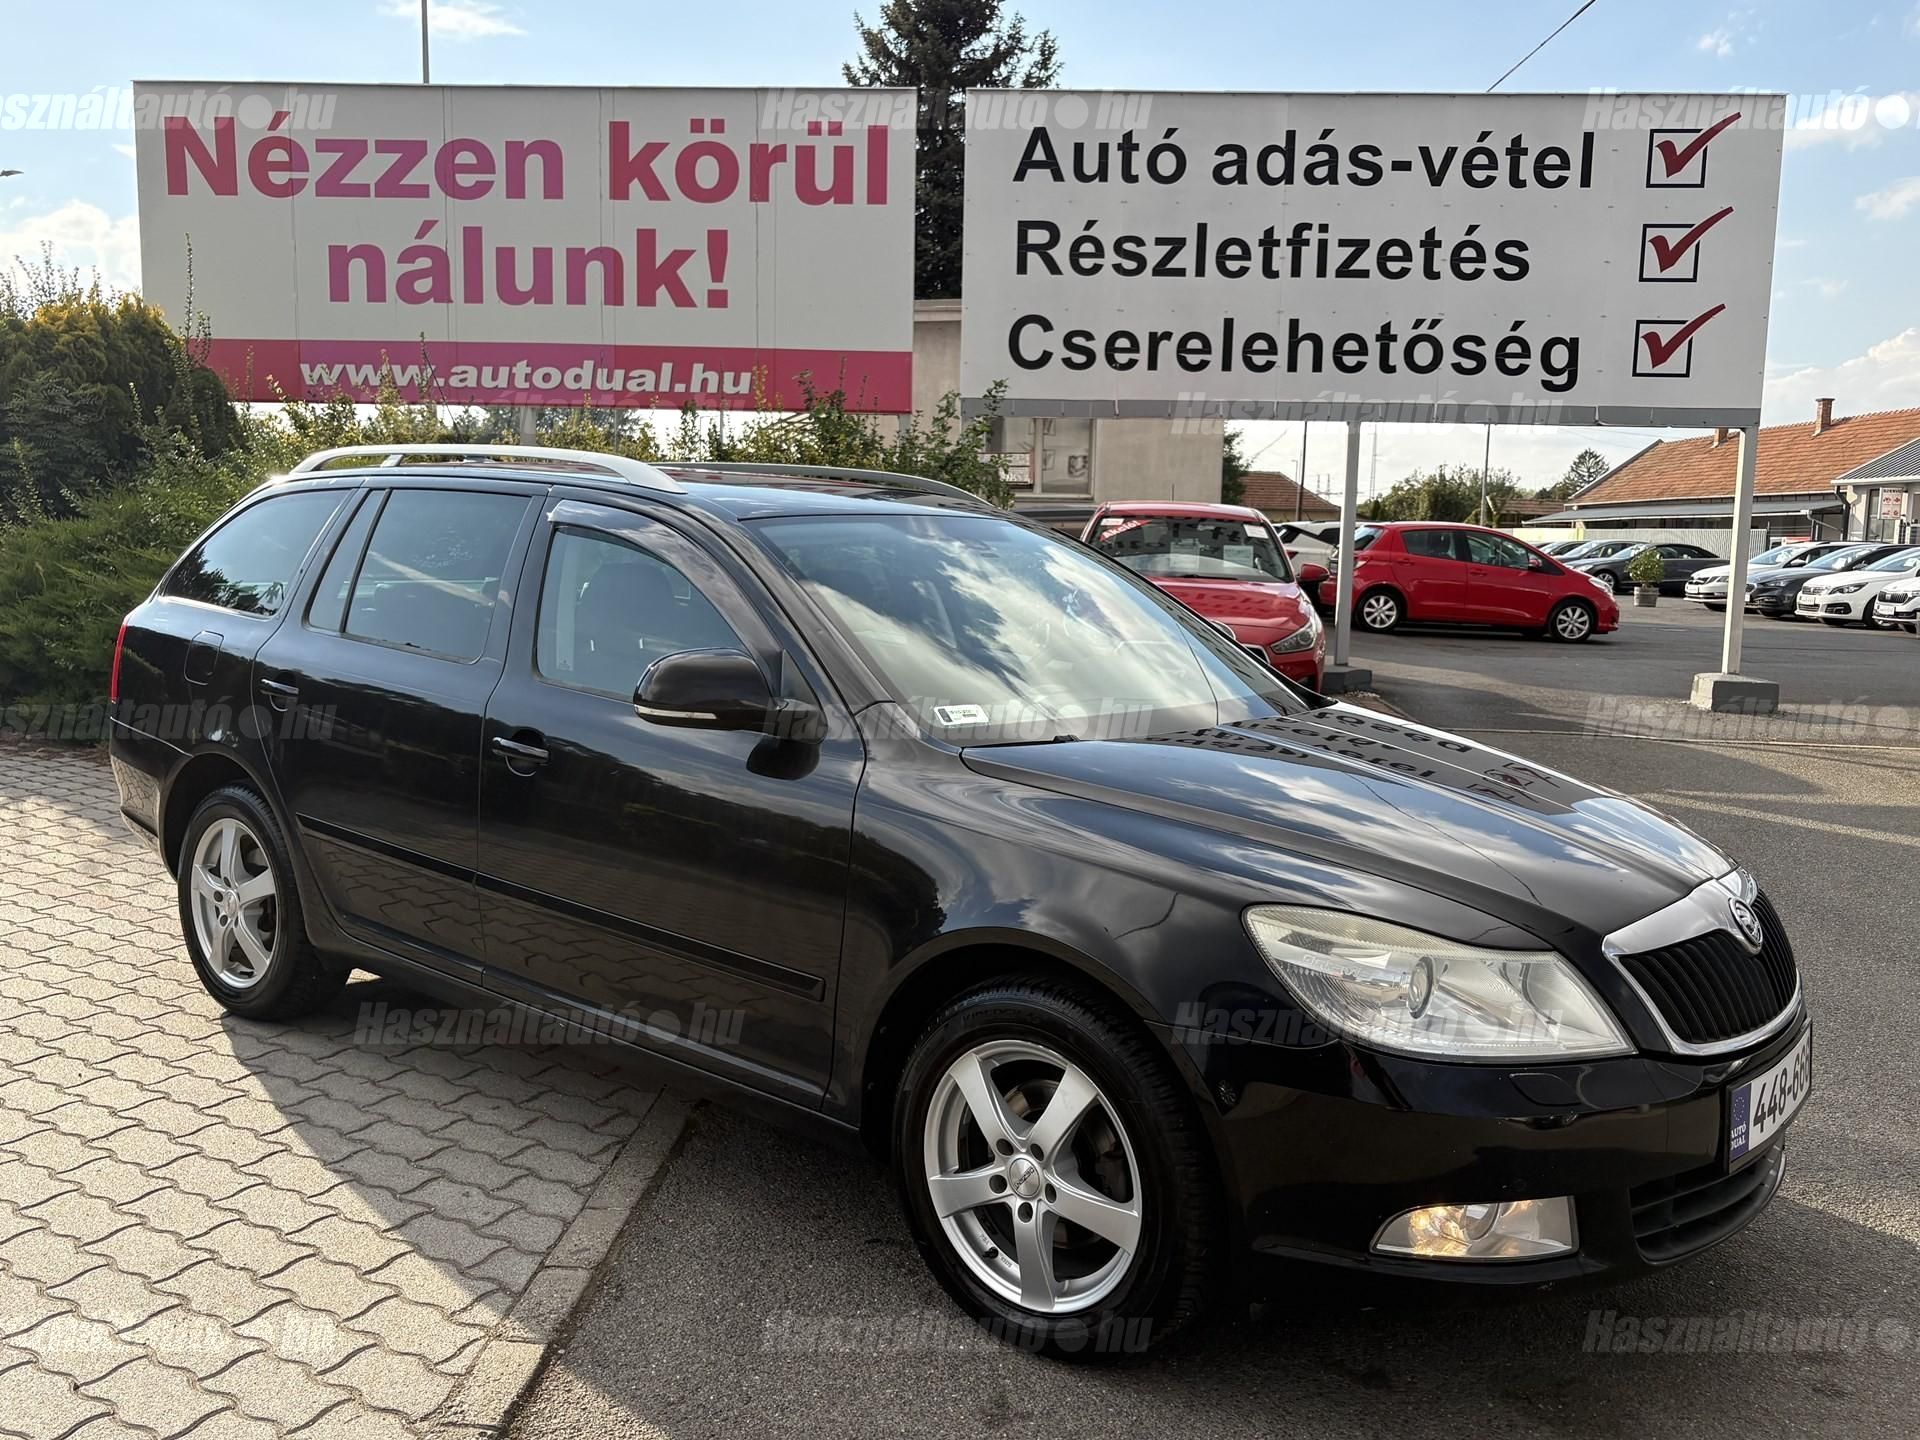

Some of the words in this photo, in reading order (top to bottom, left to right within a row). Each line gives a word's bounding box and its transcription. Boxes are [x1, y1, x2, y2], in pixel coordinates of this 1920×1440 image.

[166, 112, 564, 200] Nézzen
[609, 119, 889, 206] körül
[1012, 127, 1187, 186] Autó
[1213, 130, 1595, 189] adás-vétel
[329, 220, 729, 309] nálunk!
[1016, 221, 1531, 283] Részletfizetés
[300, 360, 752, 394] www.autodual.hu
[1007, 315, 1581, 394] Cserelehetőség
